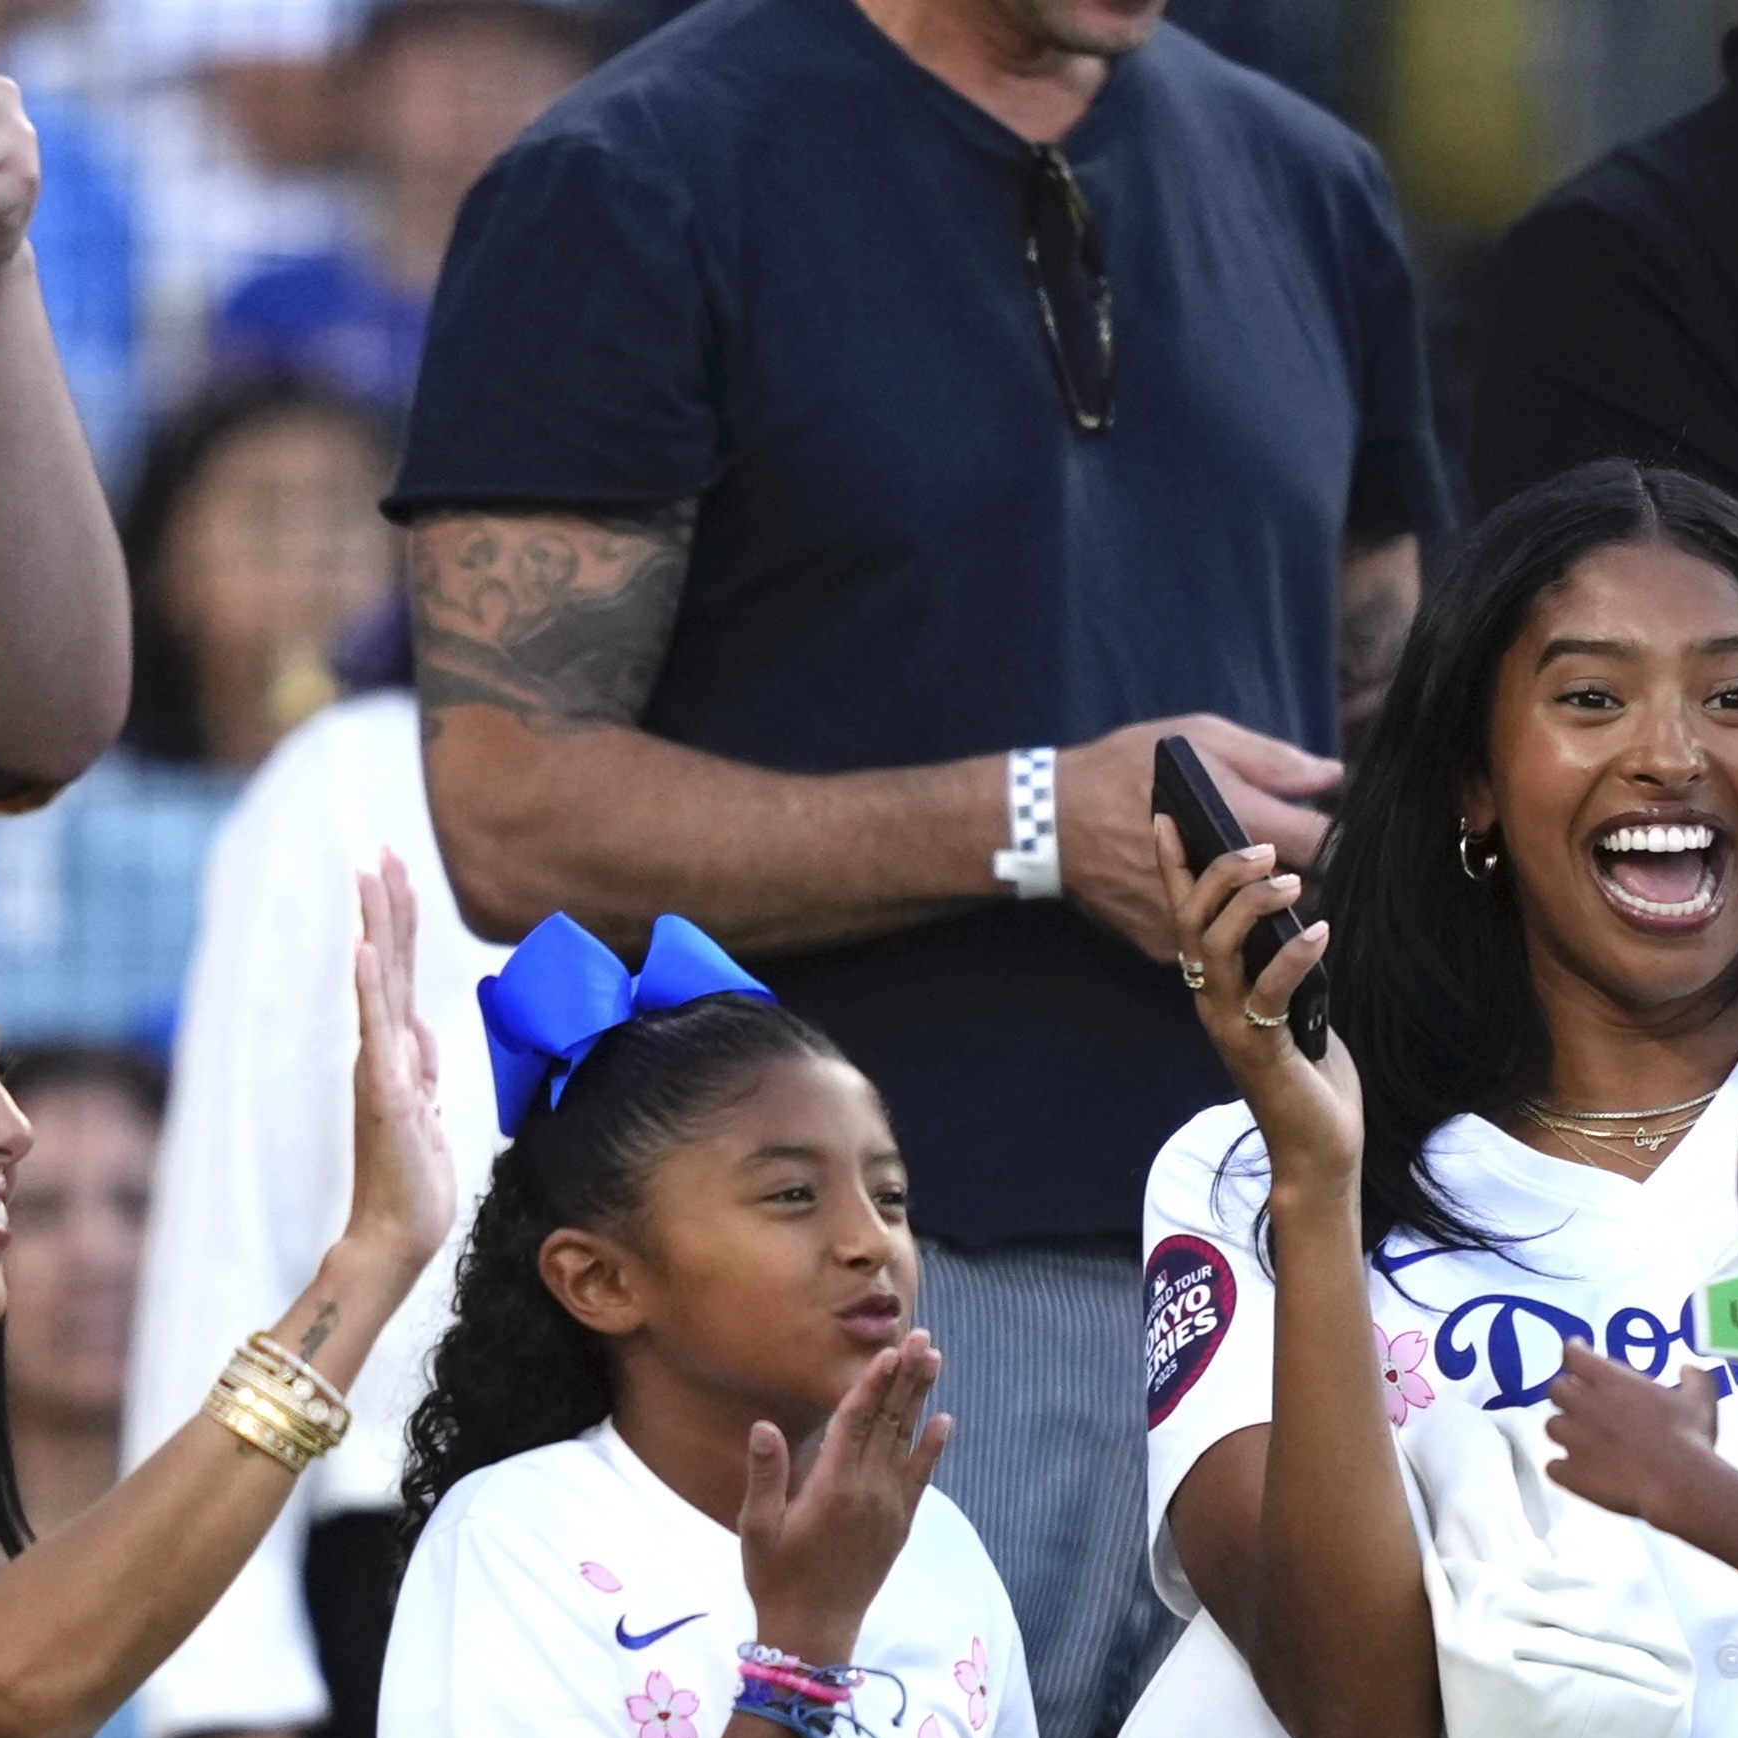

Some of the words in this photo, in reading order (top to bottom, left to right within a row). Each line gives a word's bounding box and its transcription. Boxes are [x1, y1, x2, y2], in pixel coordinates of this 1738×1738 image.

[1174, 1265, 1212, 1293] TOUR
[1145, 1284, 1212, 1358] OKYO
[1145, 1307, 1218, 1390] ERIES
[1154, 1358, 1178, 1393] 2025
